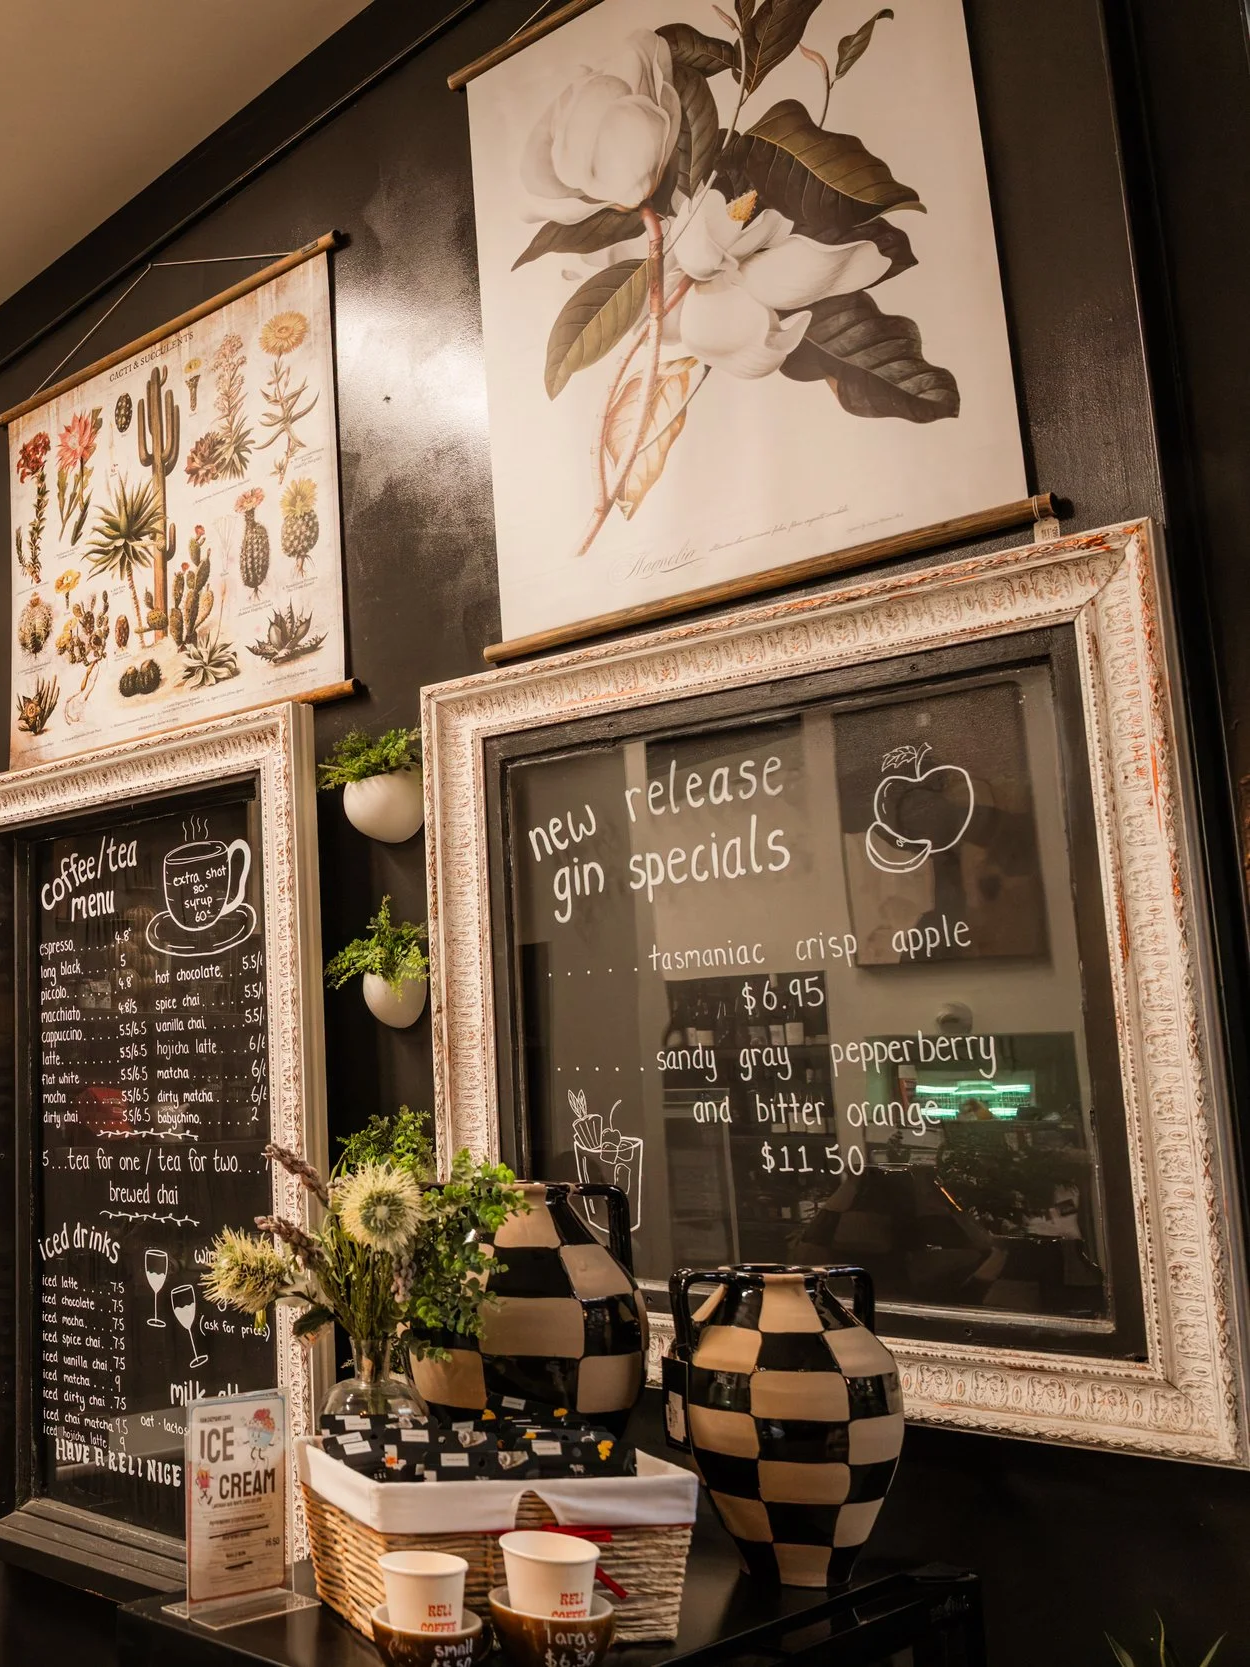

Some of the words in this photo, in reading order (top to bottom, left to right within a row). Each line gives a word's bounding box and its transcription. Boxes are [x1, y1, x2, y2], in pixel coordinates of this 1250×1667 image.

[109, 363, 133, 382] CACTI
[133, 360, 140, 370] &
[140, 331, 194, 366] SUCCULENTS
[527, 804, 597, 863] new
[624, 756, 783, 824] release
[41, 835, 137, 910] coffee/tea
[173, 871, 200, 886] extra
[205, 865, 227, 879] shot
[553, 856, 605, 923] gin
[629, 814, 792, 902] specials
[71, 890, 115, 922] menu
[184, 896, 213, 911] syrup
[40, 940, 73, 960] espresso
[648, 940, 765, 972] tasmaniac
[795, 931, 858, 967] crisp
[891, 914, 972, 959] apple
[41, 966, 56, 987] long
[60, 959, 81, 976] black
[120, 953, 127, 967] 5
[155, 970, 170, 984] hot
[176, 964, 221, 982] chocolate
[41, 986, 67, 1005] piccolo
[155, 998, 177, 1014] spice
[182, 993, 200, 1006] chai
[244, 982, 264, 999] 5.5/
[740, 976, 825, 1015] $6.95
[41, 1006, 81, 1023] macchiato
[155, 1018, 184, 1032] vanilla
[188, 1016, 205, 1029] chai
[245, 1007, 265, 1026] 5.5/
[42, 1027, 82, 1048] cappuccino
[156, 1039, 189, 1060] hojicha
[195, 1038, 217, 1054] latte
[42, 1050, 61, 1065] latte
[656, 1043, 717, 1083] sandy
[738, 1043, 792, 1082] gray
[830, 1030, 998, 1079] pepperberry
[42, 1073, 55, 1085] flat
[58, 1072, 80, 1084] white
[156, 1067, 189, 1079] matcha
[43, 1090, 66, 1103] mocha
[157, 1089, 179, 1109] dirty
[183, 1089, 213, 1103] matcha
[43, 1110, 61, 1128] dirty
[63, 1110, 78, 1122] chai
[157, 1110, 200, 1129] babychino
[251, 1106, 260, 1121] 2
[692, 1095, 732, 1125] and
[756, 1092, 826, 1126] bitter
[847, 1095, 941, 1136] orange
[96, 1147, 113, 1170] for
[119, 1155, 141, 1171] one
[158, 1147, 182, 1172] tea
[188, 1148, 208, 1172] for
[213, 1149, 238, 1173] two
[760, 1141, 865, 1176] $11.50
[109, 1180, 150, 1205] brewed
[157, 1183, 179, 1205] chai
[37, 1222, 69, 1262] iced
[73, 1221, 121, 1265] drinks
[41, 1274, 57, 1288] iced
[61, 1275, 79, 1290] latte
[41, 1292, 57, 1305] iced
[61, 1295, 95, 1310] chocolate
[41, 1310, 57, 1324] iced
[61, 1315, 85, 1328] mocha
[199, 1315, 219, 1336] (ask
[222, 1320, 235, 1333] for
[41, 1330, 58, 1343] iced
[62, 1333, 82, 1347] spice
[85, 1335, 101, 1348] chai
[41, 1350, 58, 1363] iced
[63, 1355, 88, 1369] vanilla
[92, 1358, 108, 1371] chai
[41, 1369, 58, 1381] iced
[63, 1372, 90, 1387] matcha
[115, 1375, 121, 1393] 9
[170, 1379, 206, 1407] milk
[41, 1386, 58, 1401] iced
[63, 1390, 86, 1412] dirty
[89, 1395, 105, 1407] chai
[41, 1407, 59, 1422] iced
[64, 1411, 80, 1425] chai
[84, 1417, 114, 1433] matcha
[140, 1415, 155, 1428] oat
[41, 1423, 58, 1437] iced
[90, 1431, 108, 1449] latte
[119, 1436, 126, 1451] 9
[200, 1426, 234, 1463] ICE
[55, 1437, 90, 1465] HAVE
[94, 1446, 105, 1467] A
[146, 1458, 182, 1488] NICE
[219, 1468, 276, 1500] CREAM
[434, 1637, 473, 1657] small
[547, 1627, 597, 1654] large
